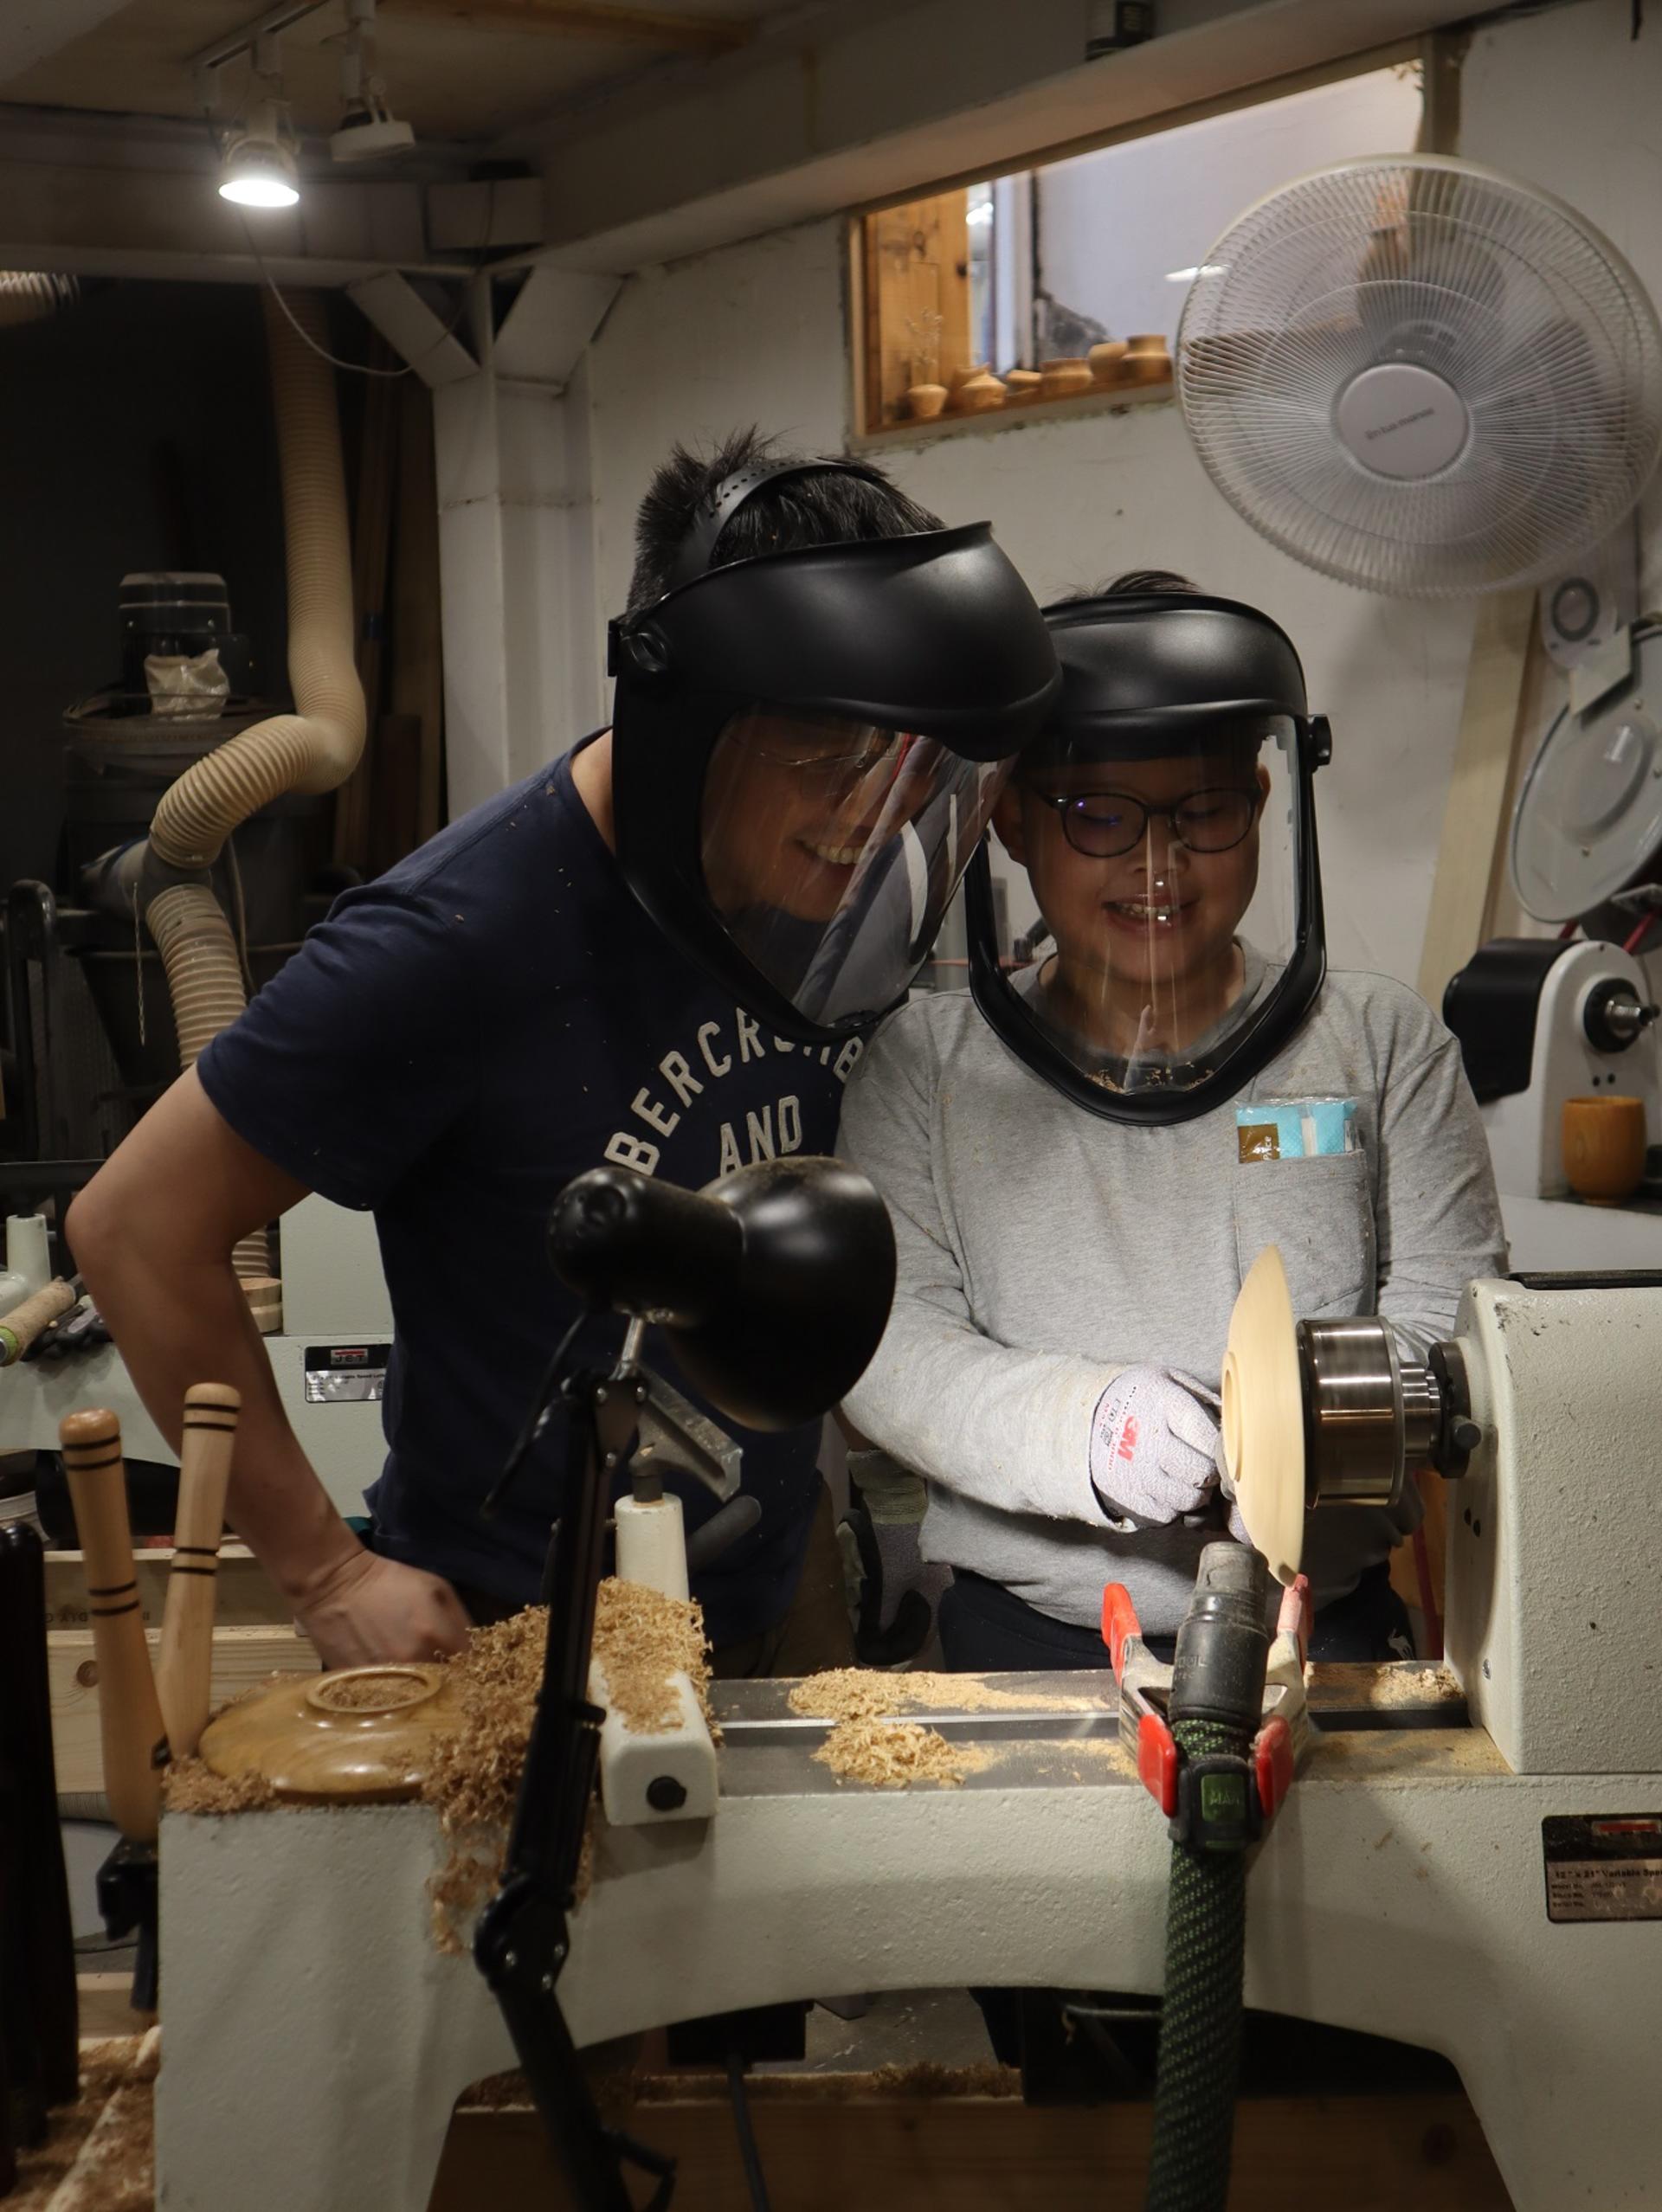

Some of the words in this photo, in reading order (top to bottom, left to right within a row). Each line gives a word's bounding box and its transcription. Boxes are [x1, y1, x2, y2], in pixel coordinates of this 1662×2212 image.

[719, 1095, 802, 1178] AND
[335, 1354, 365, 1363] JET
[1117, 1415, 1139, 1463] 3M
[1601, 1868, 1640, 1877] Variable
